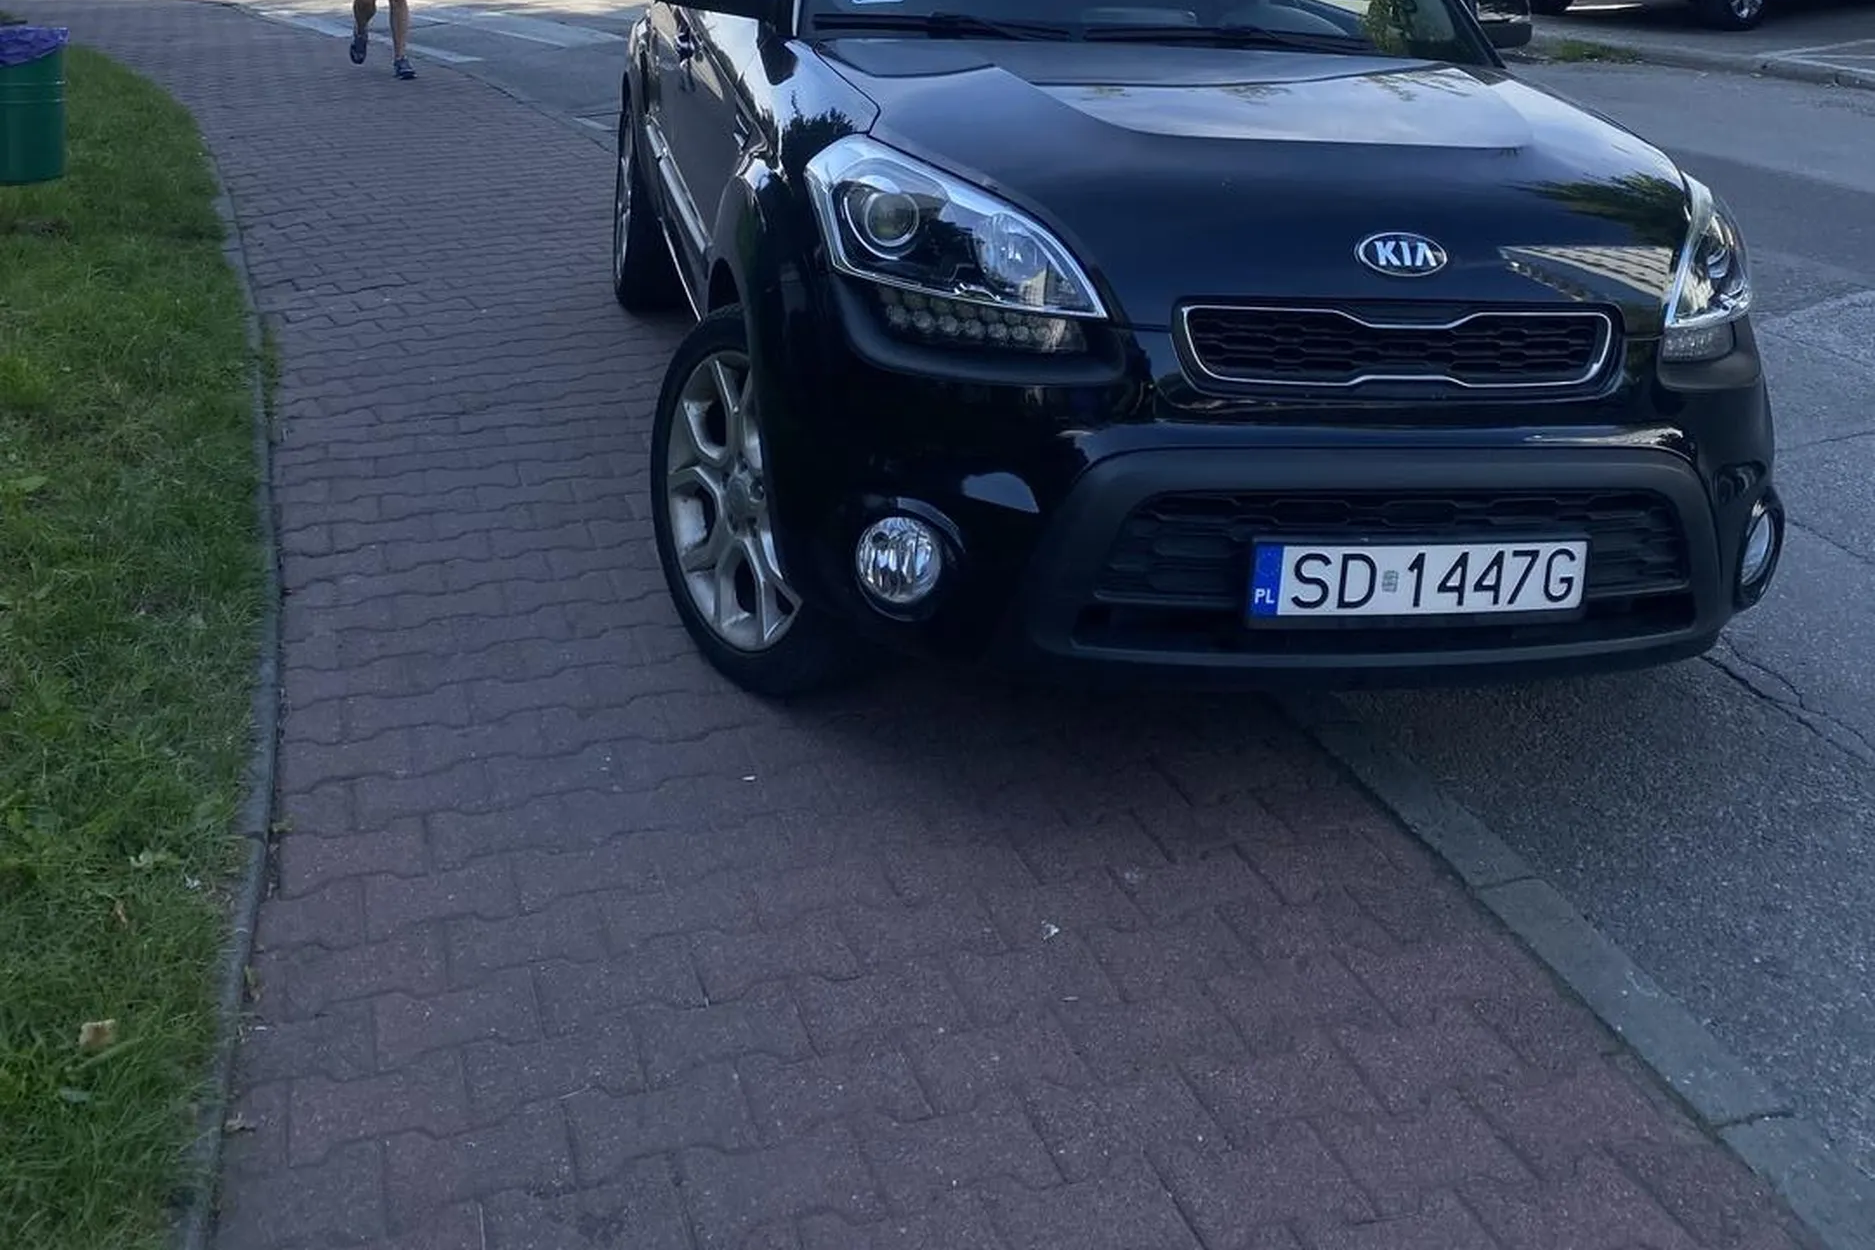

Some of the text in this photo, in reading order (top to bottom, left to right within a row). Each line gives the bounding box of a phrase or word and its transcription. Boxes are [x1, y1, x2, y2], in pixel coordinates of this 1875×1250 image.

[1373, 241, 1437, 267] KIA
[1254, 548, 1576, 609] PL SD 1447G
